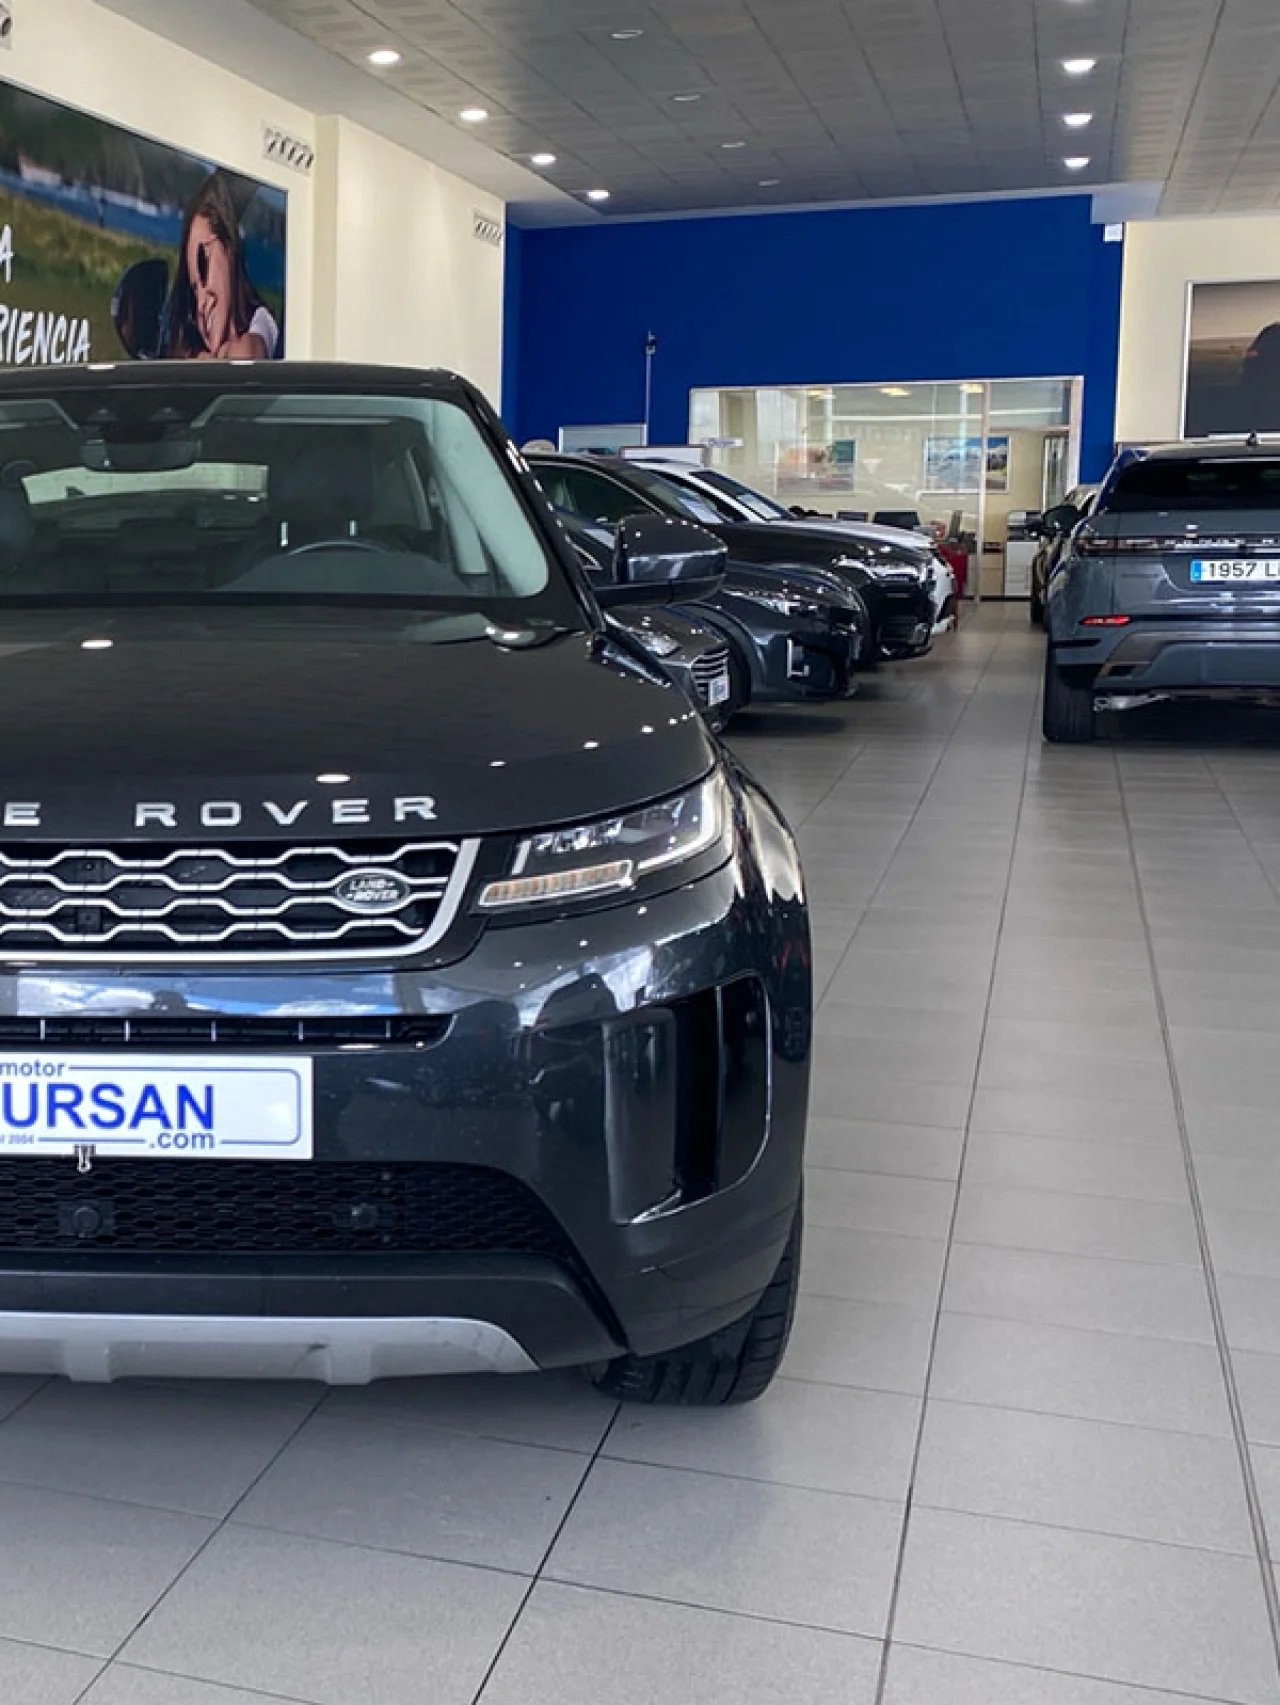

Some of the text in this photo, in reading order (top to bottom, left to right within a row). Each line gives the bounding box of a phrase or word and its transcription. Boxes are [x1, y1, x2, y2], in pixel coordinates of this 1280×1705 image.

[1209, 562, 1257, 577] 1957
[134, 796, 437, 828] ROVER
[353, 889, 398, 901] ROVER
[148, 1132, 216, 1149] .com
